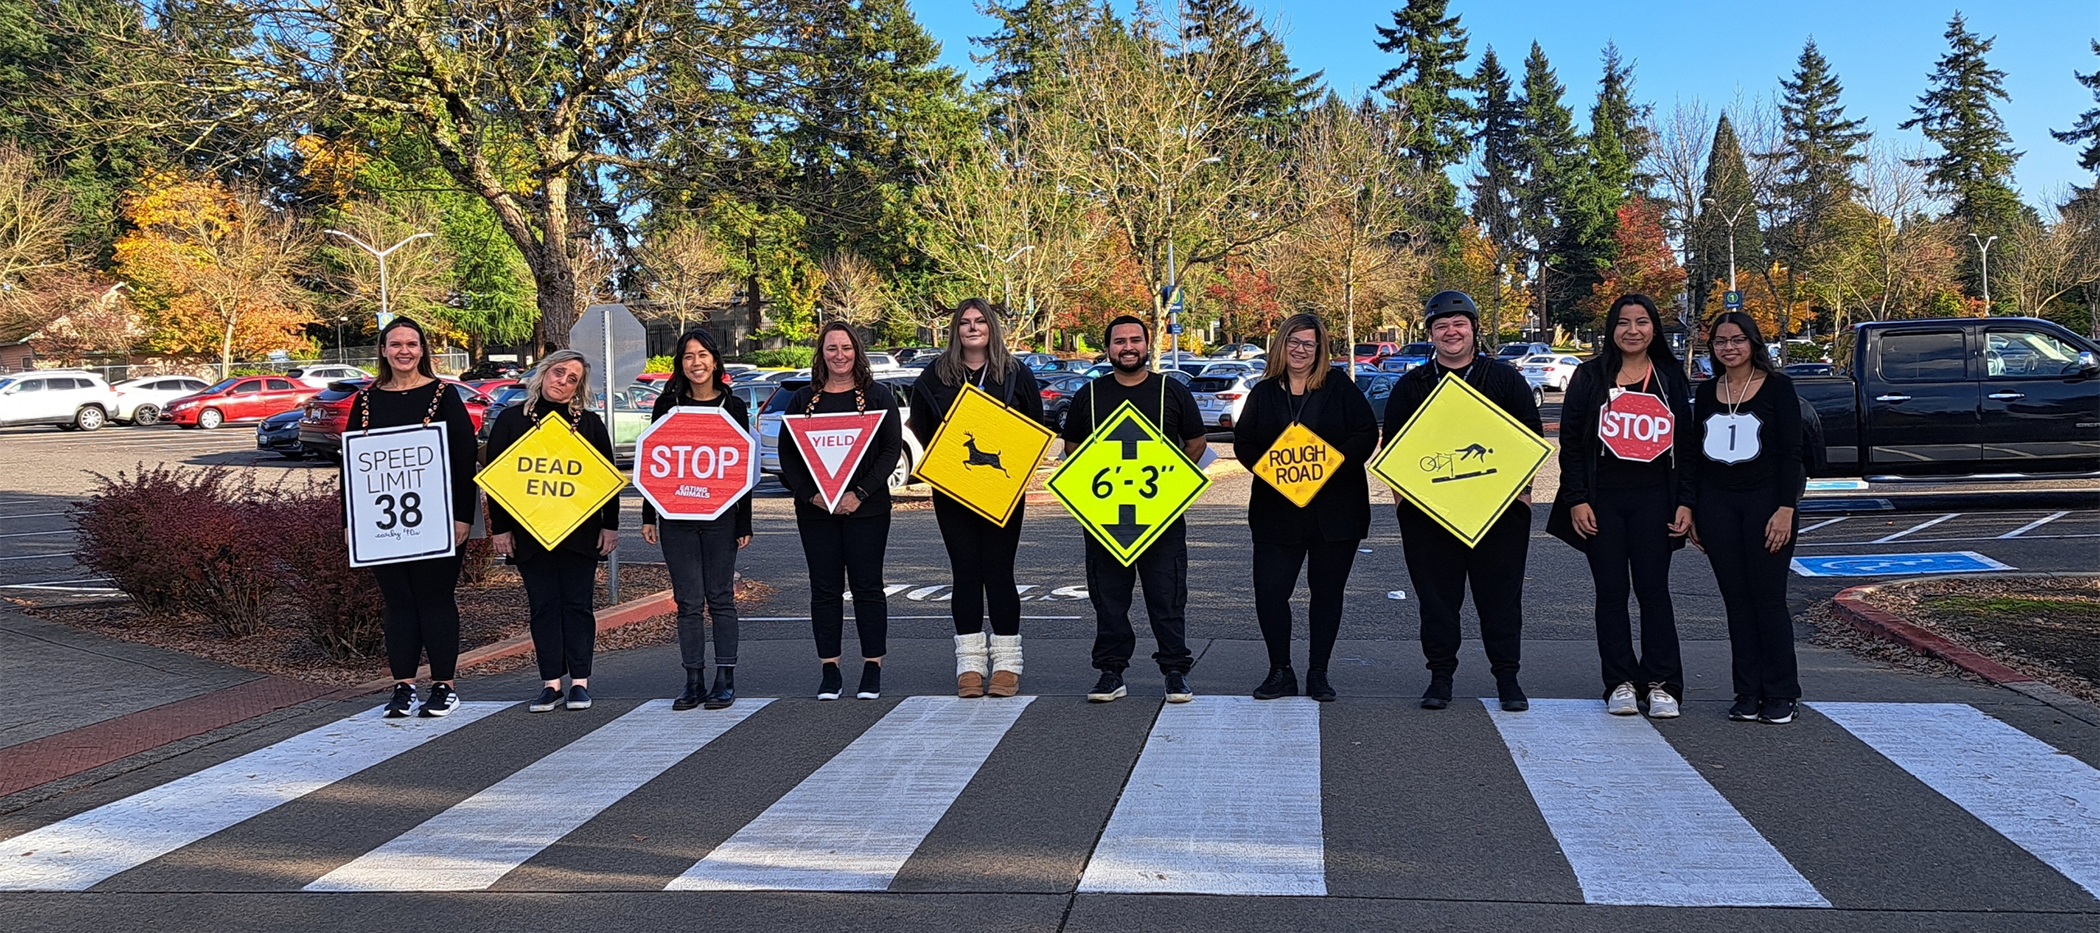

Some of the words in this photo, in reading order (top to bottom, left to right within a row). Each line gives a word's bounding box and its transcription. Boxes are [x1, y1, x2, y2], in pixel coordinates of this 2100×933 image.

[1601, 411, 1671, 443] STOP
[1727, 424, 1737, 451] 1
[811, 434, 855, 448] YIELD
[358, 446, 434, 472] SPEED
[517, 456, 583, 476] DEAD
[649, 445, 740, 479] STOP
[1269, 444, 1326, 467] ROUGH
[367, 468, 425, 494] LIMIT
[1275, 463, 1324, 485] ROAD
[526, 478, 576, 498] END
[674, 489, 711, 499] ANIMALS
[679, 484, 709, 493] EATING
[374, 491, 423, 530] 38
